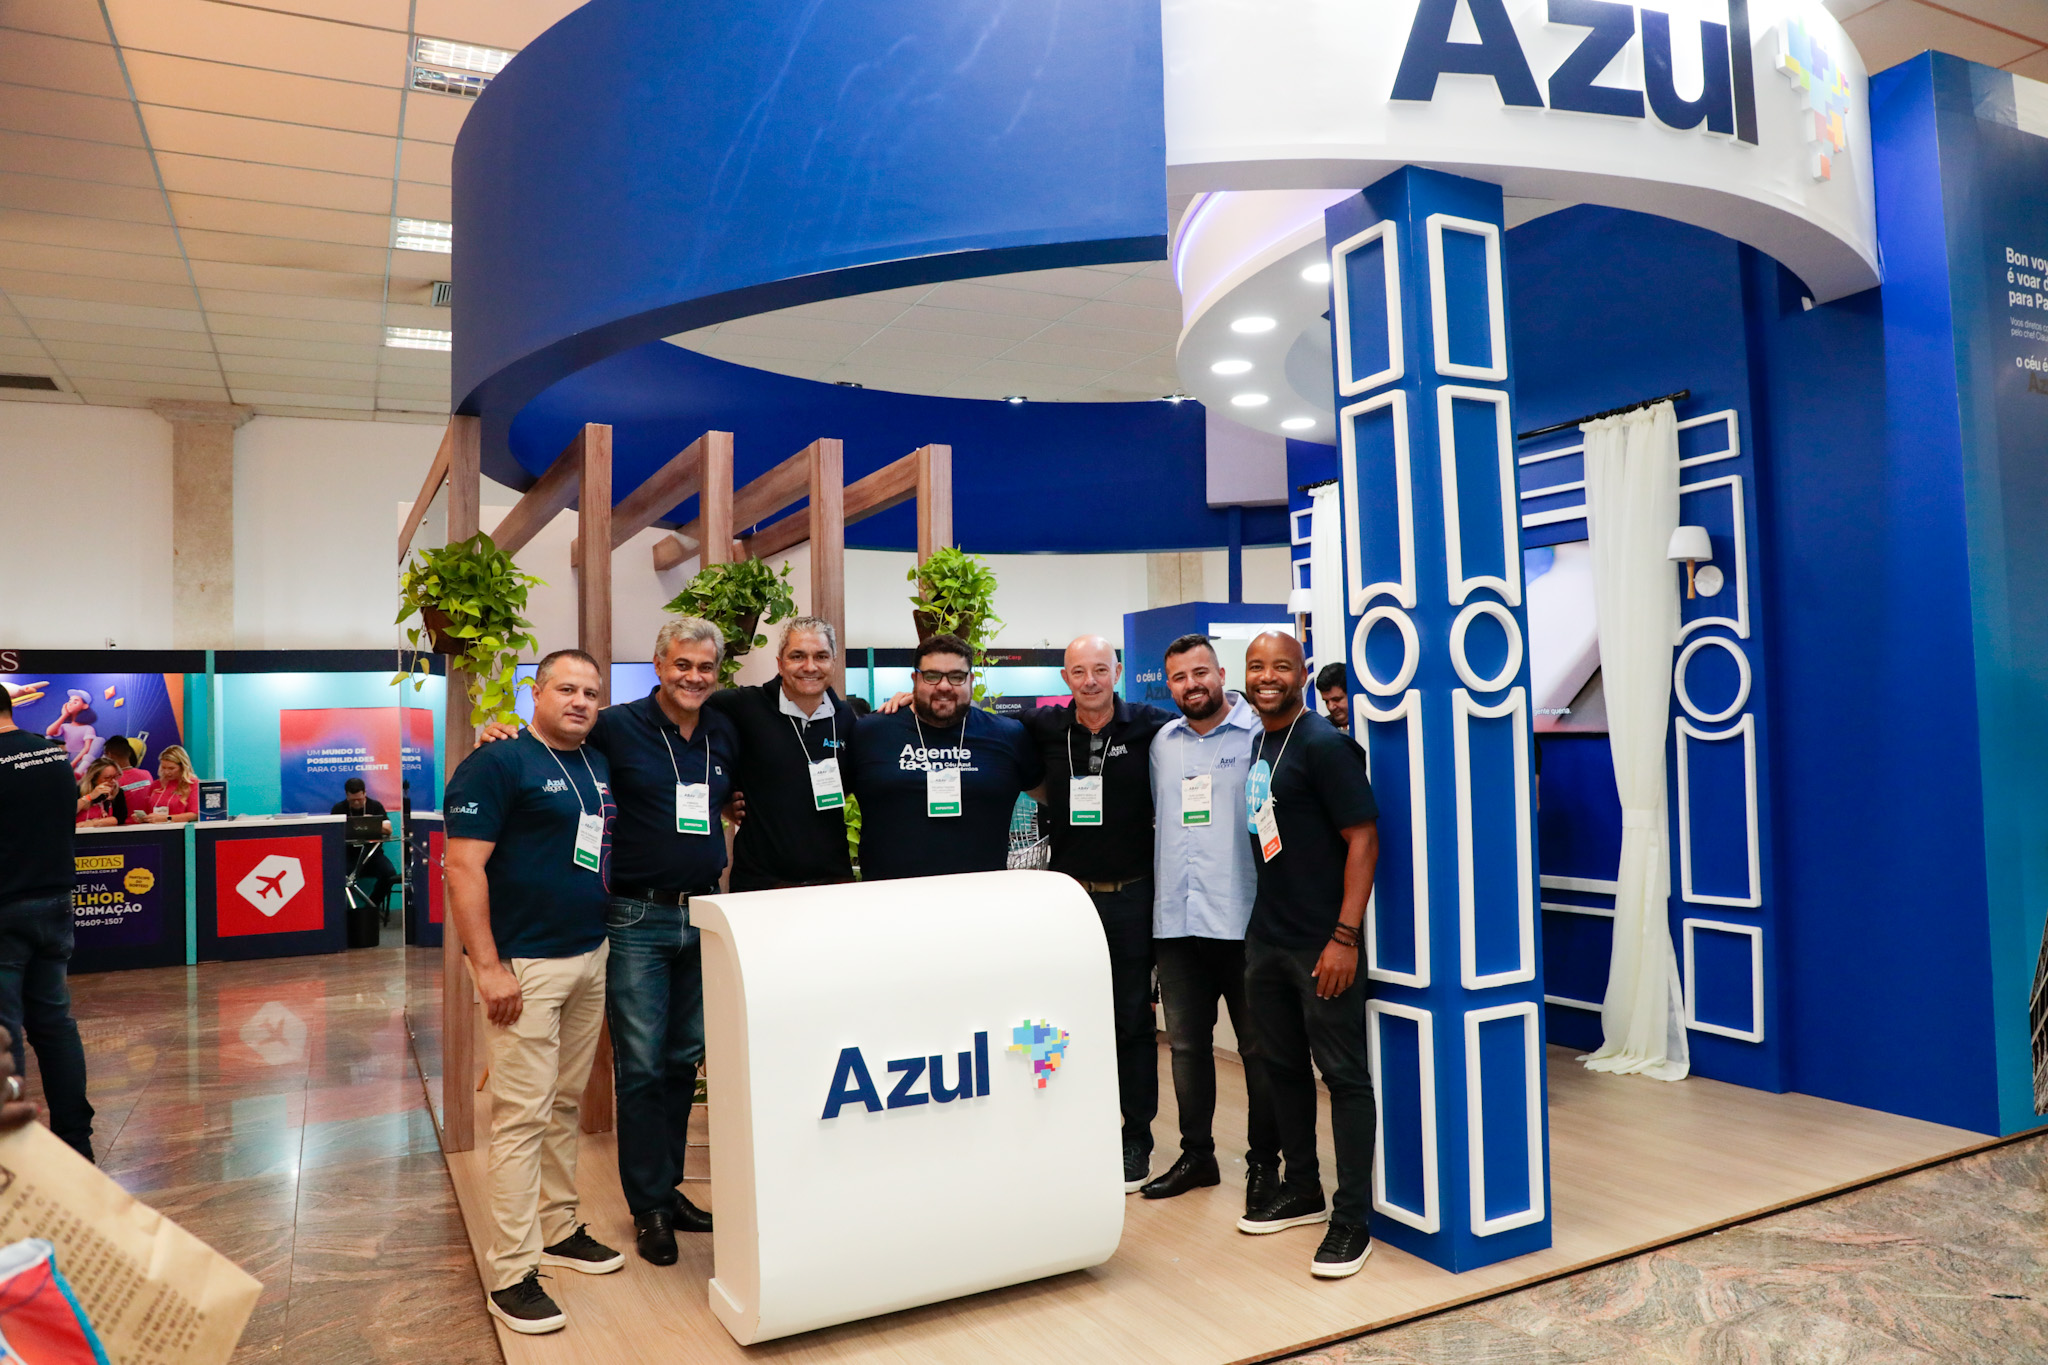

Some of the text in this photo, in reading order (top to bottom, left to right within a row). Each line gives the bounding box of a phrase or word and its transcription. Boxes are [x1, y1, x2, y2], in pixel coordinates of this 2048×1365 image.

[1389, 0, 1759, 145] Azul
[2006, 247, 2029, 267] Bon
[2007, 267, 2015, 284] é
[2017, 273, 2041, 289] voar
[2009, 291, 2034, 307] para
[2016, 357, 2023, 367] o
[2024, 355, 2041, 371] céu
[0, 651, 19, 672] S
[1136, 668, 1162, 683] o céu é
[307, 756, 375, 764] POSSIBILIDADES
[900, 744, 971, 762] Agente
[14, 759, 44, 769] Agentes
[338, 764, 354, 772] SEU
[71, 883, 108, 893] JE NA
[73, 902, 143, 917] ORMAÇÃO
[821, 1031, 991, 1120] Azul
